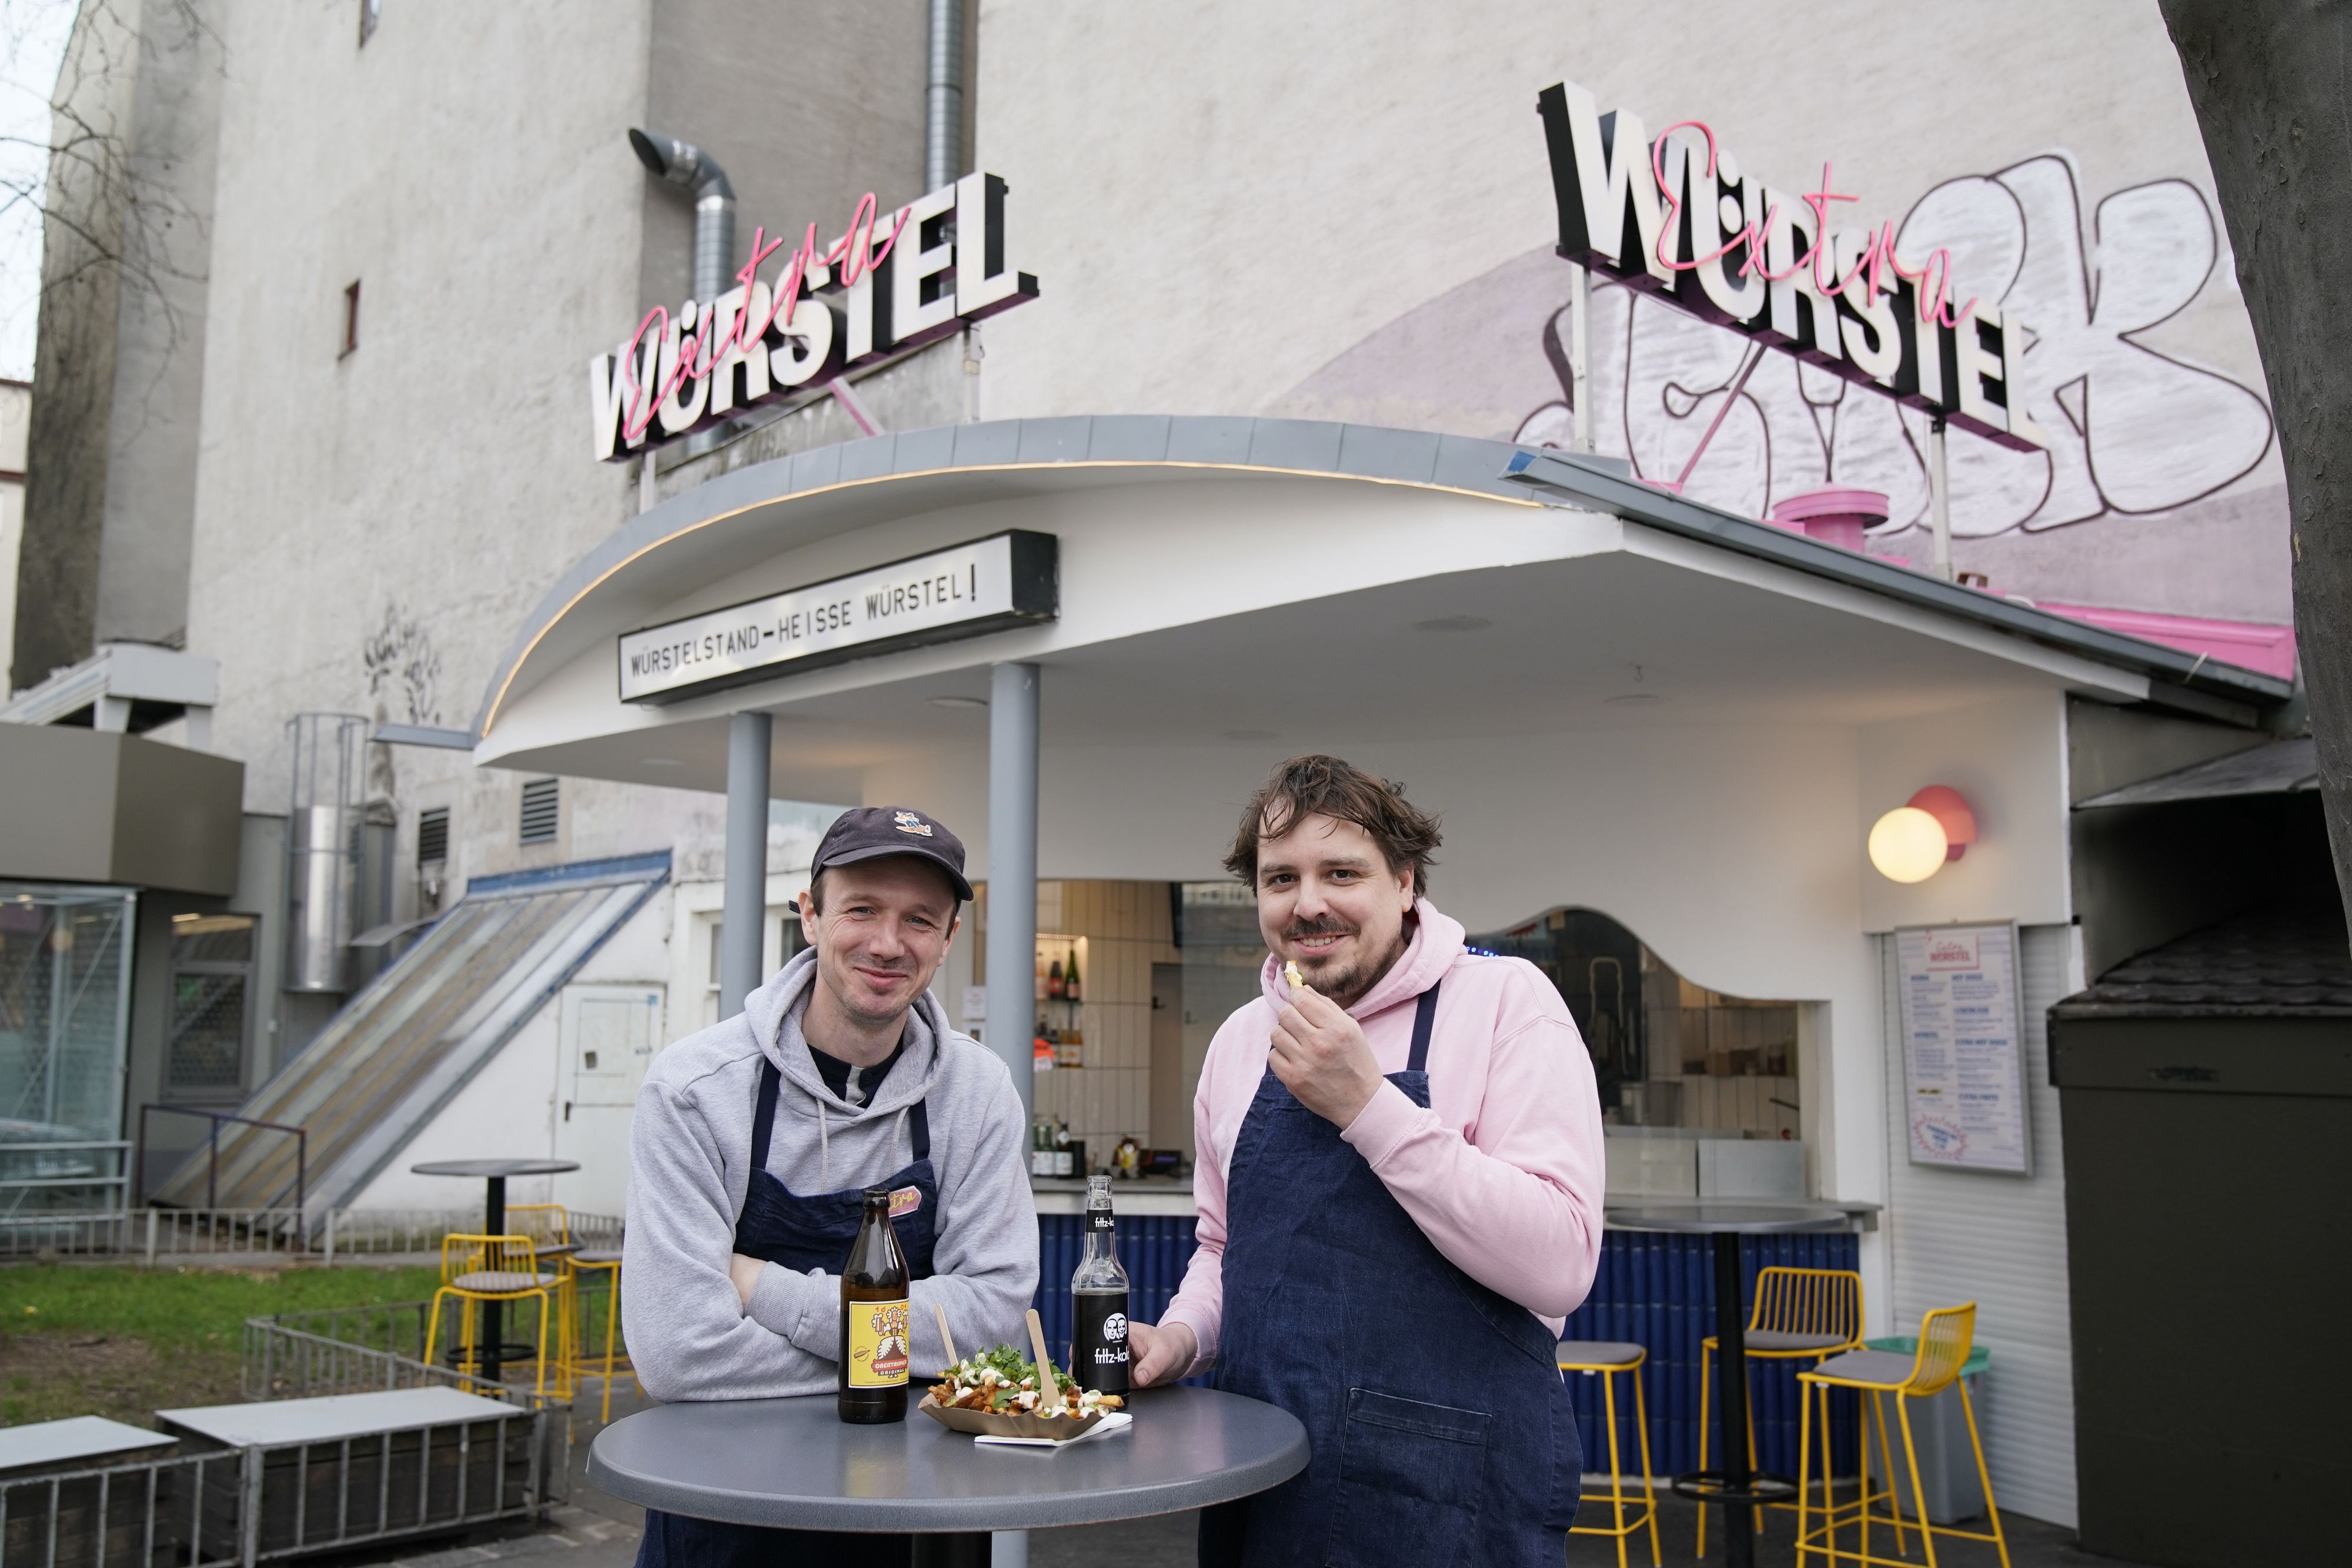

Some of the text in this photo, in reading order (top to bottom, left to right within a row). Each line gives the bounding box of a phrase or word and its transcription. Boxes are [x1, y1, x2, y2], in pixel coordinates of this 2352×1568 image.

[1653, 121, 1978, 329] Extra
[622, 192, 911, 440] Extra
[866, 563, 976, 620] WÜRSTEL!
[888, 1192, 918, 1211] tra
